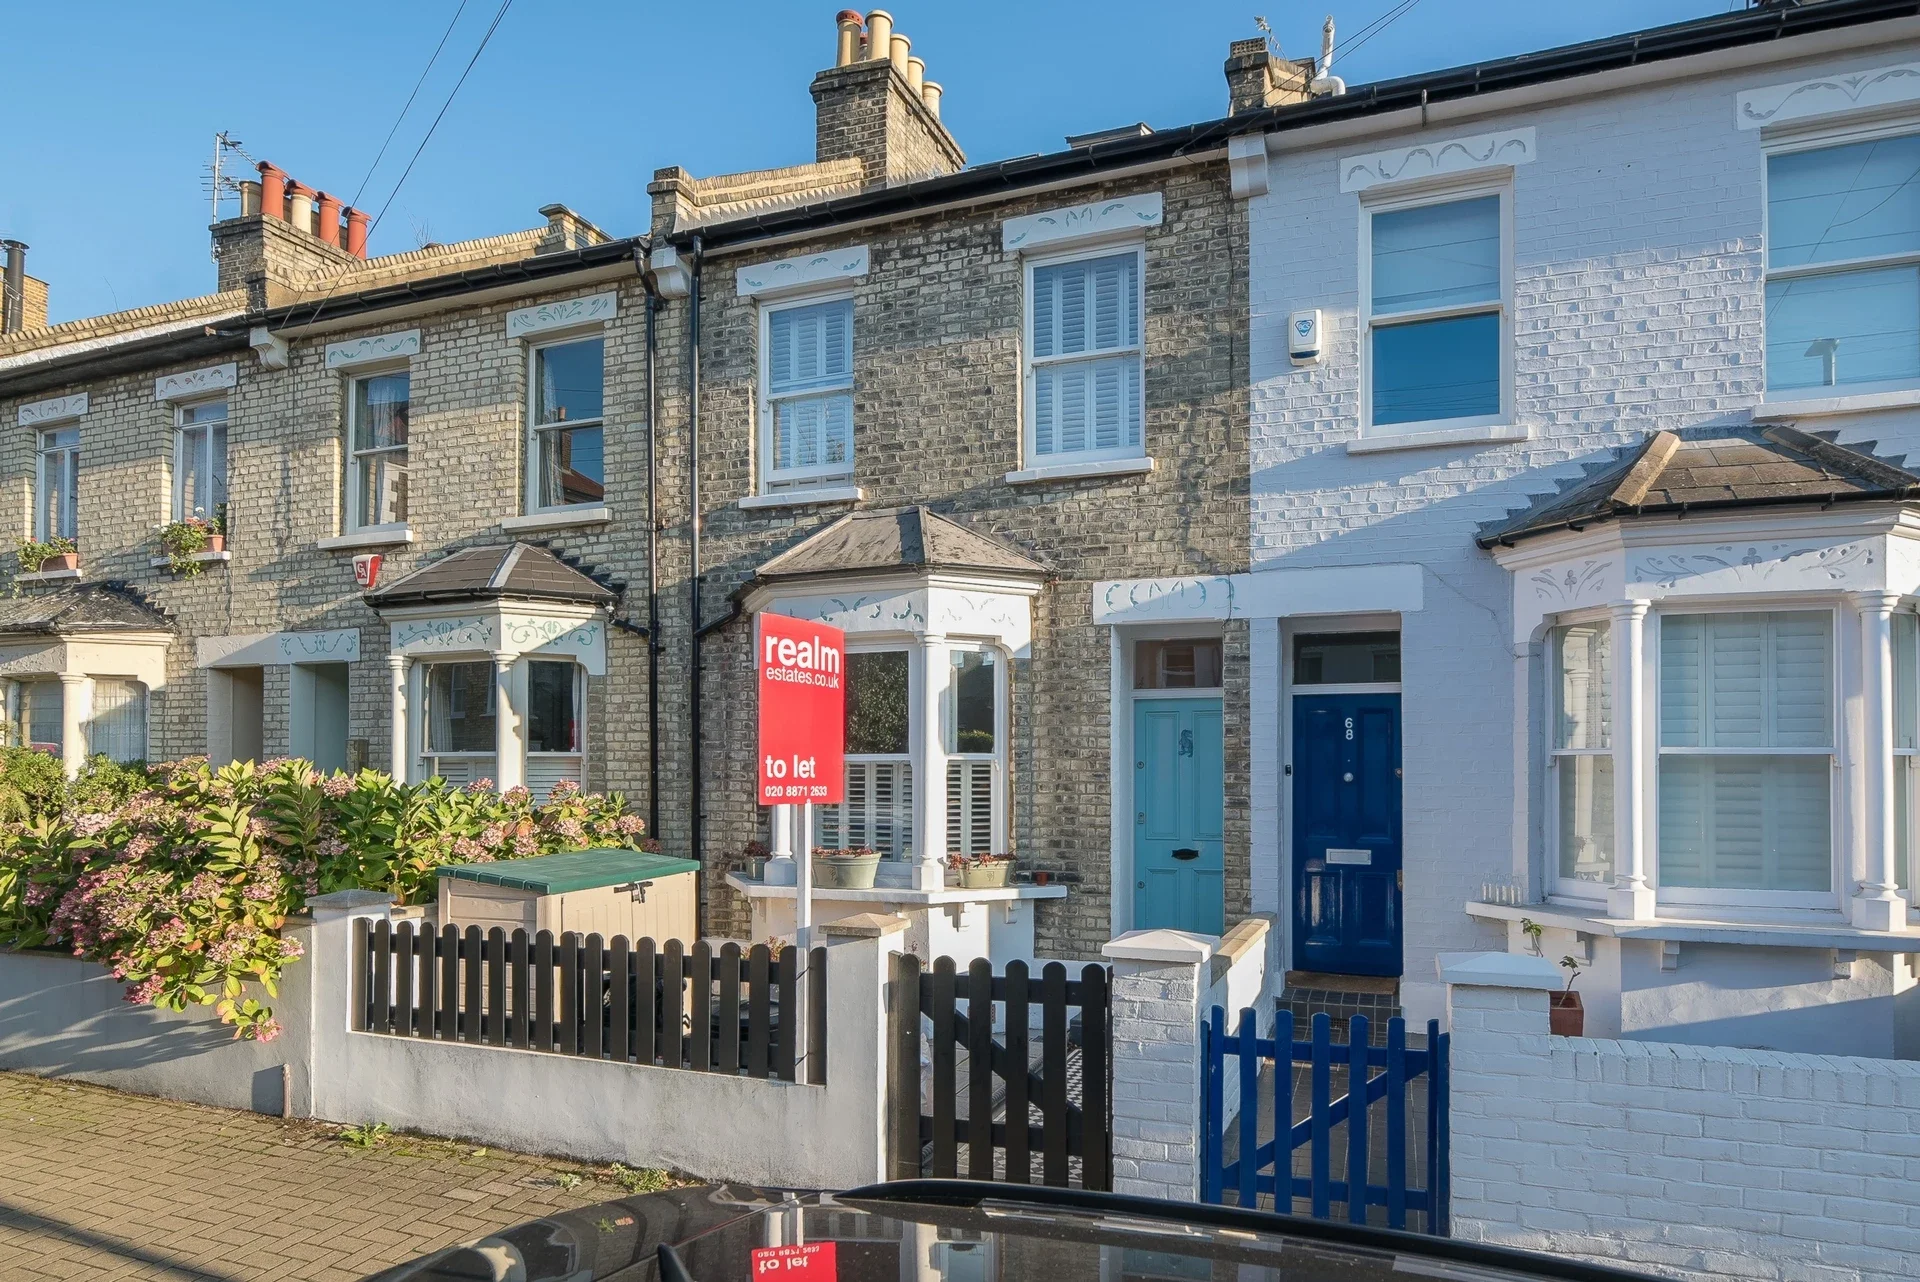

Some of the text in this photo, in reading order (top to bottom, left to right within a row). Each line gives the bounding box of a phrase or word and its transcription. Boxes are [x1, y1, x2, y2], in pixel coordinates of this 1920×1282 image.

[765, 635, 840, 674] realm
[766, 666, 839, 689] estates.co.uk
[1345, 717, 1354, 740] 68
[765, 754, 816, 778] to let
[765, 785, 827, 797] 020 8871 2633
